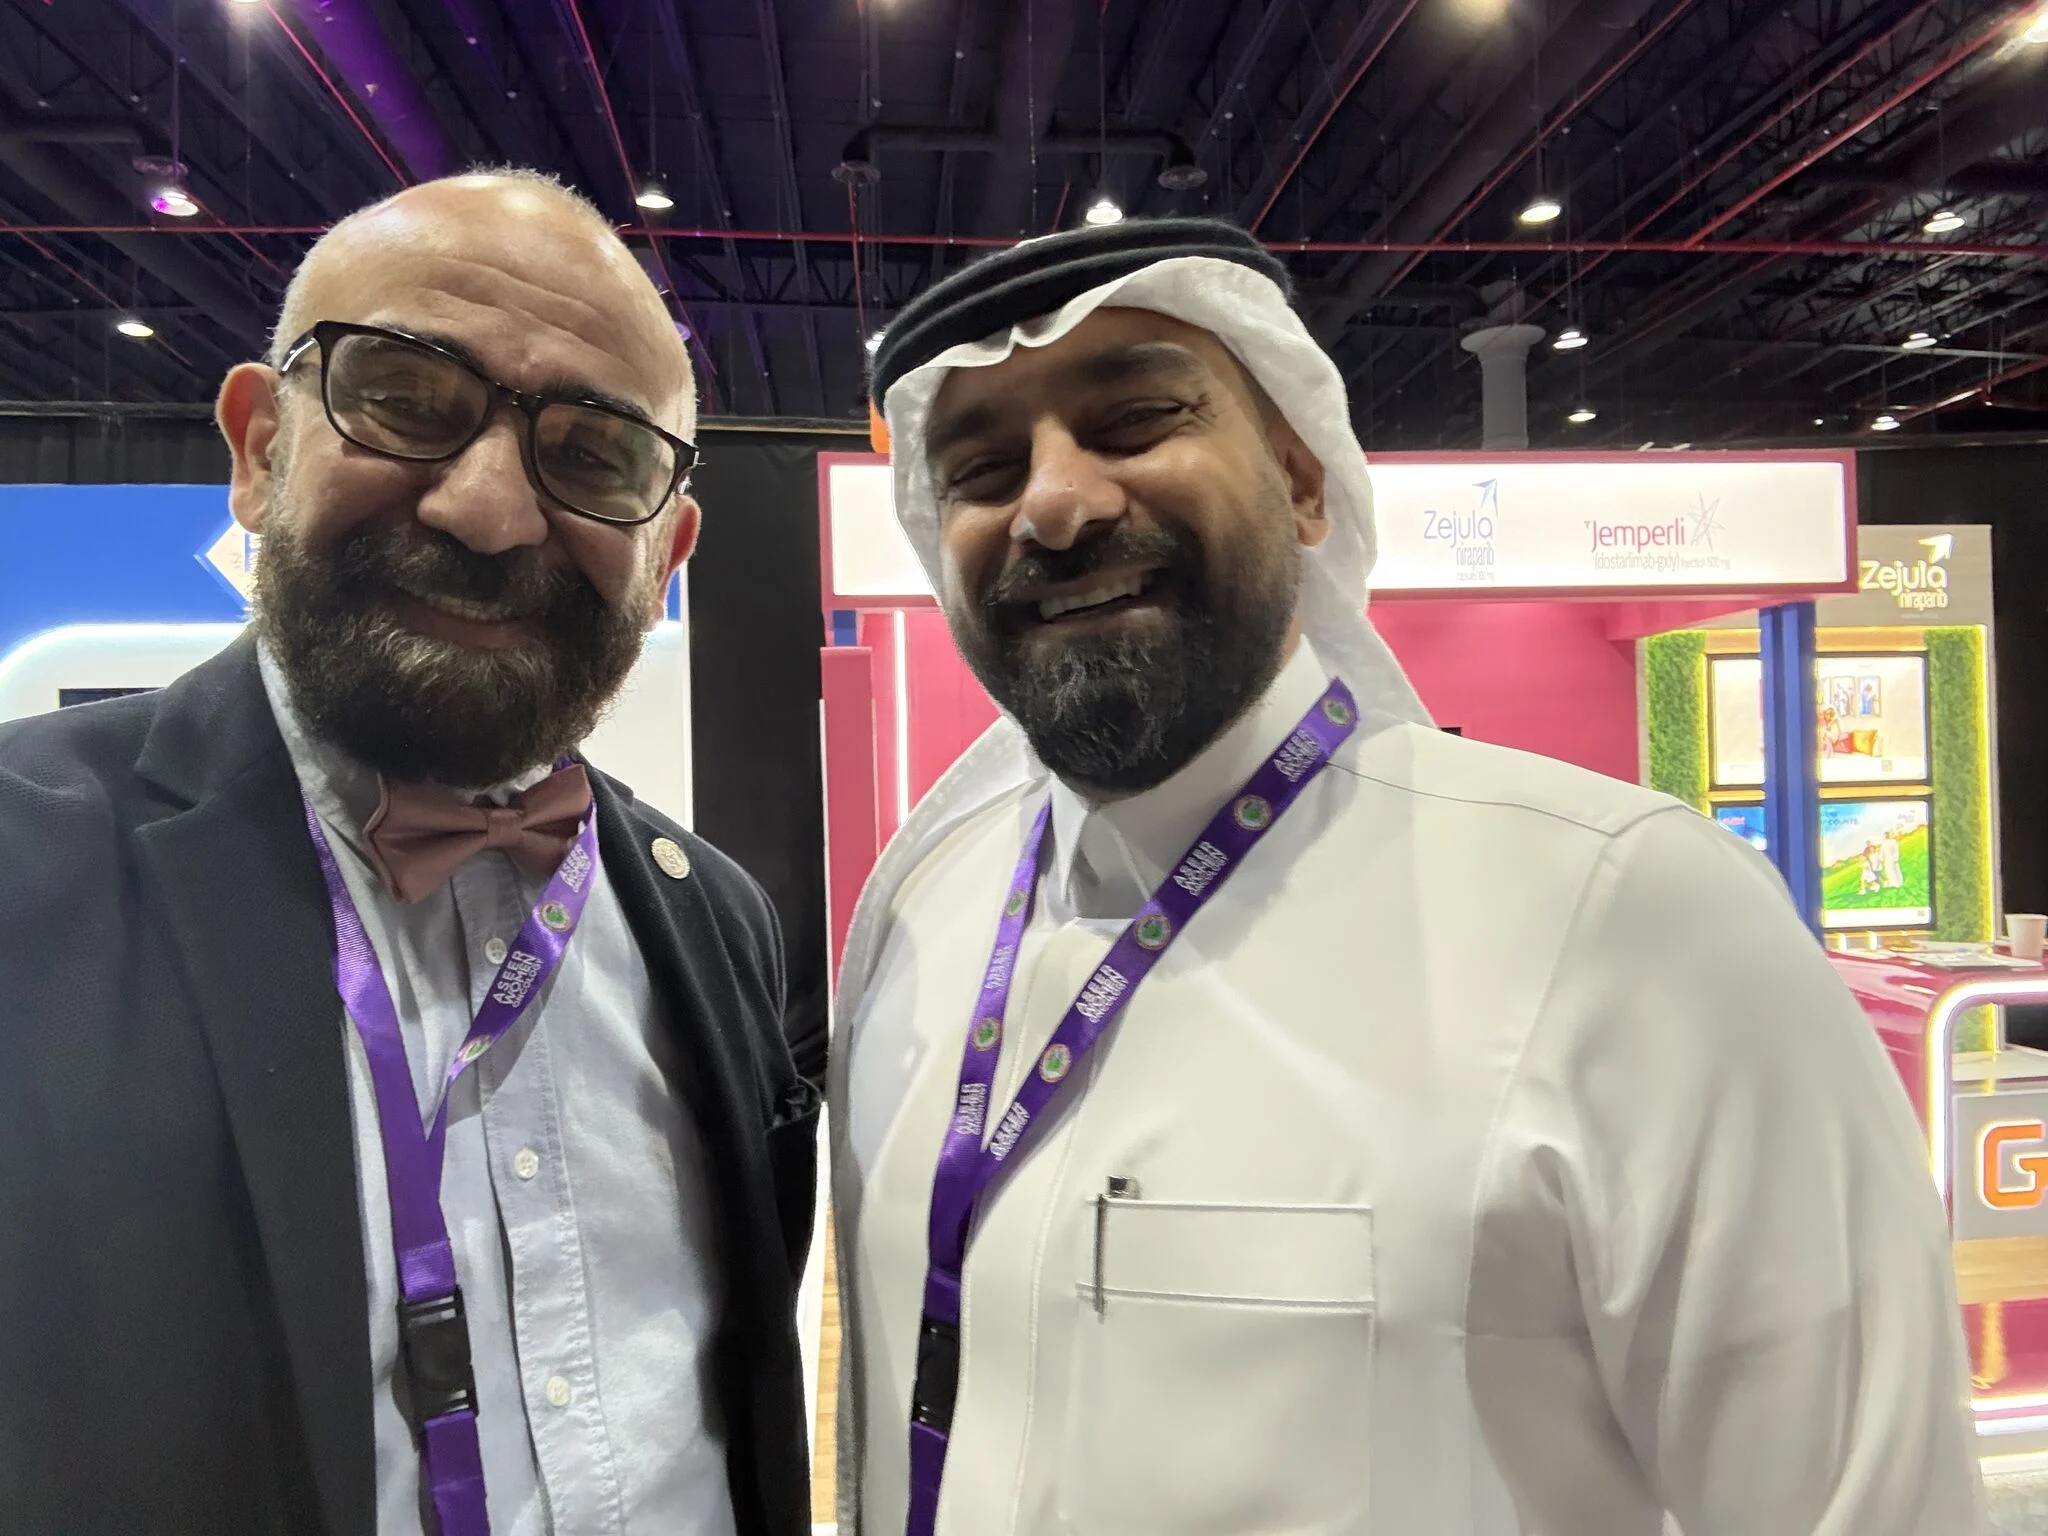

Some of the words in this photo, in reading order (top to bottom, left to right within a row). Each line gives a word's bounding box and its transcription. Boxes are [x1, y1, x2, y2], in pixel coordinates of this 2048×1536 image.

[1423, 509, 1493, 548] Zejula
[1592, 517, 1685, 553] Jemperli
[1858, 560, 1948, 596] Zejula
[492, 950, 521, 1003] ASEER
[502, 953, 537, 1004] WOMEN
